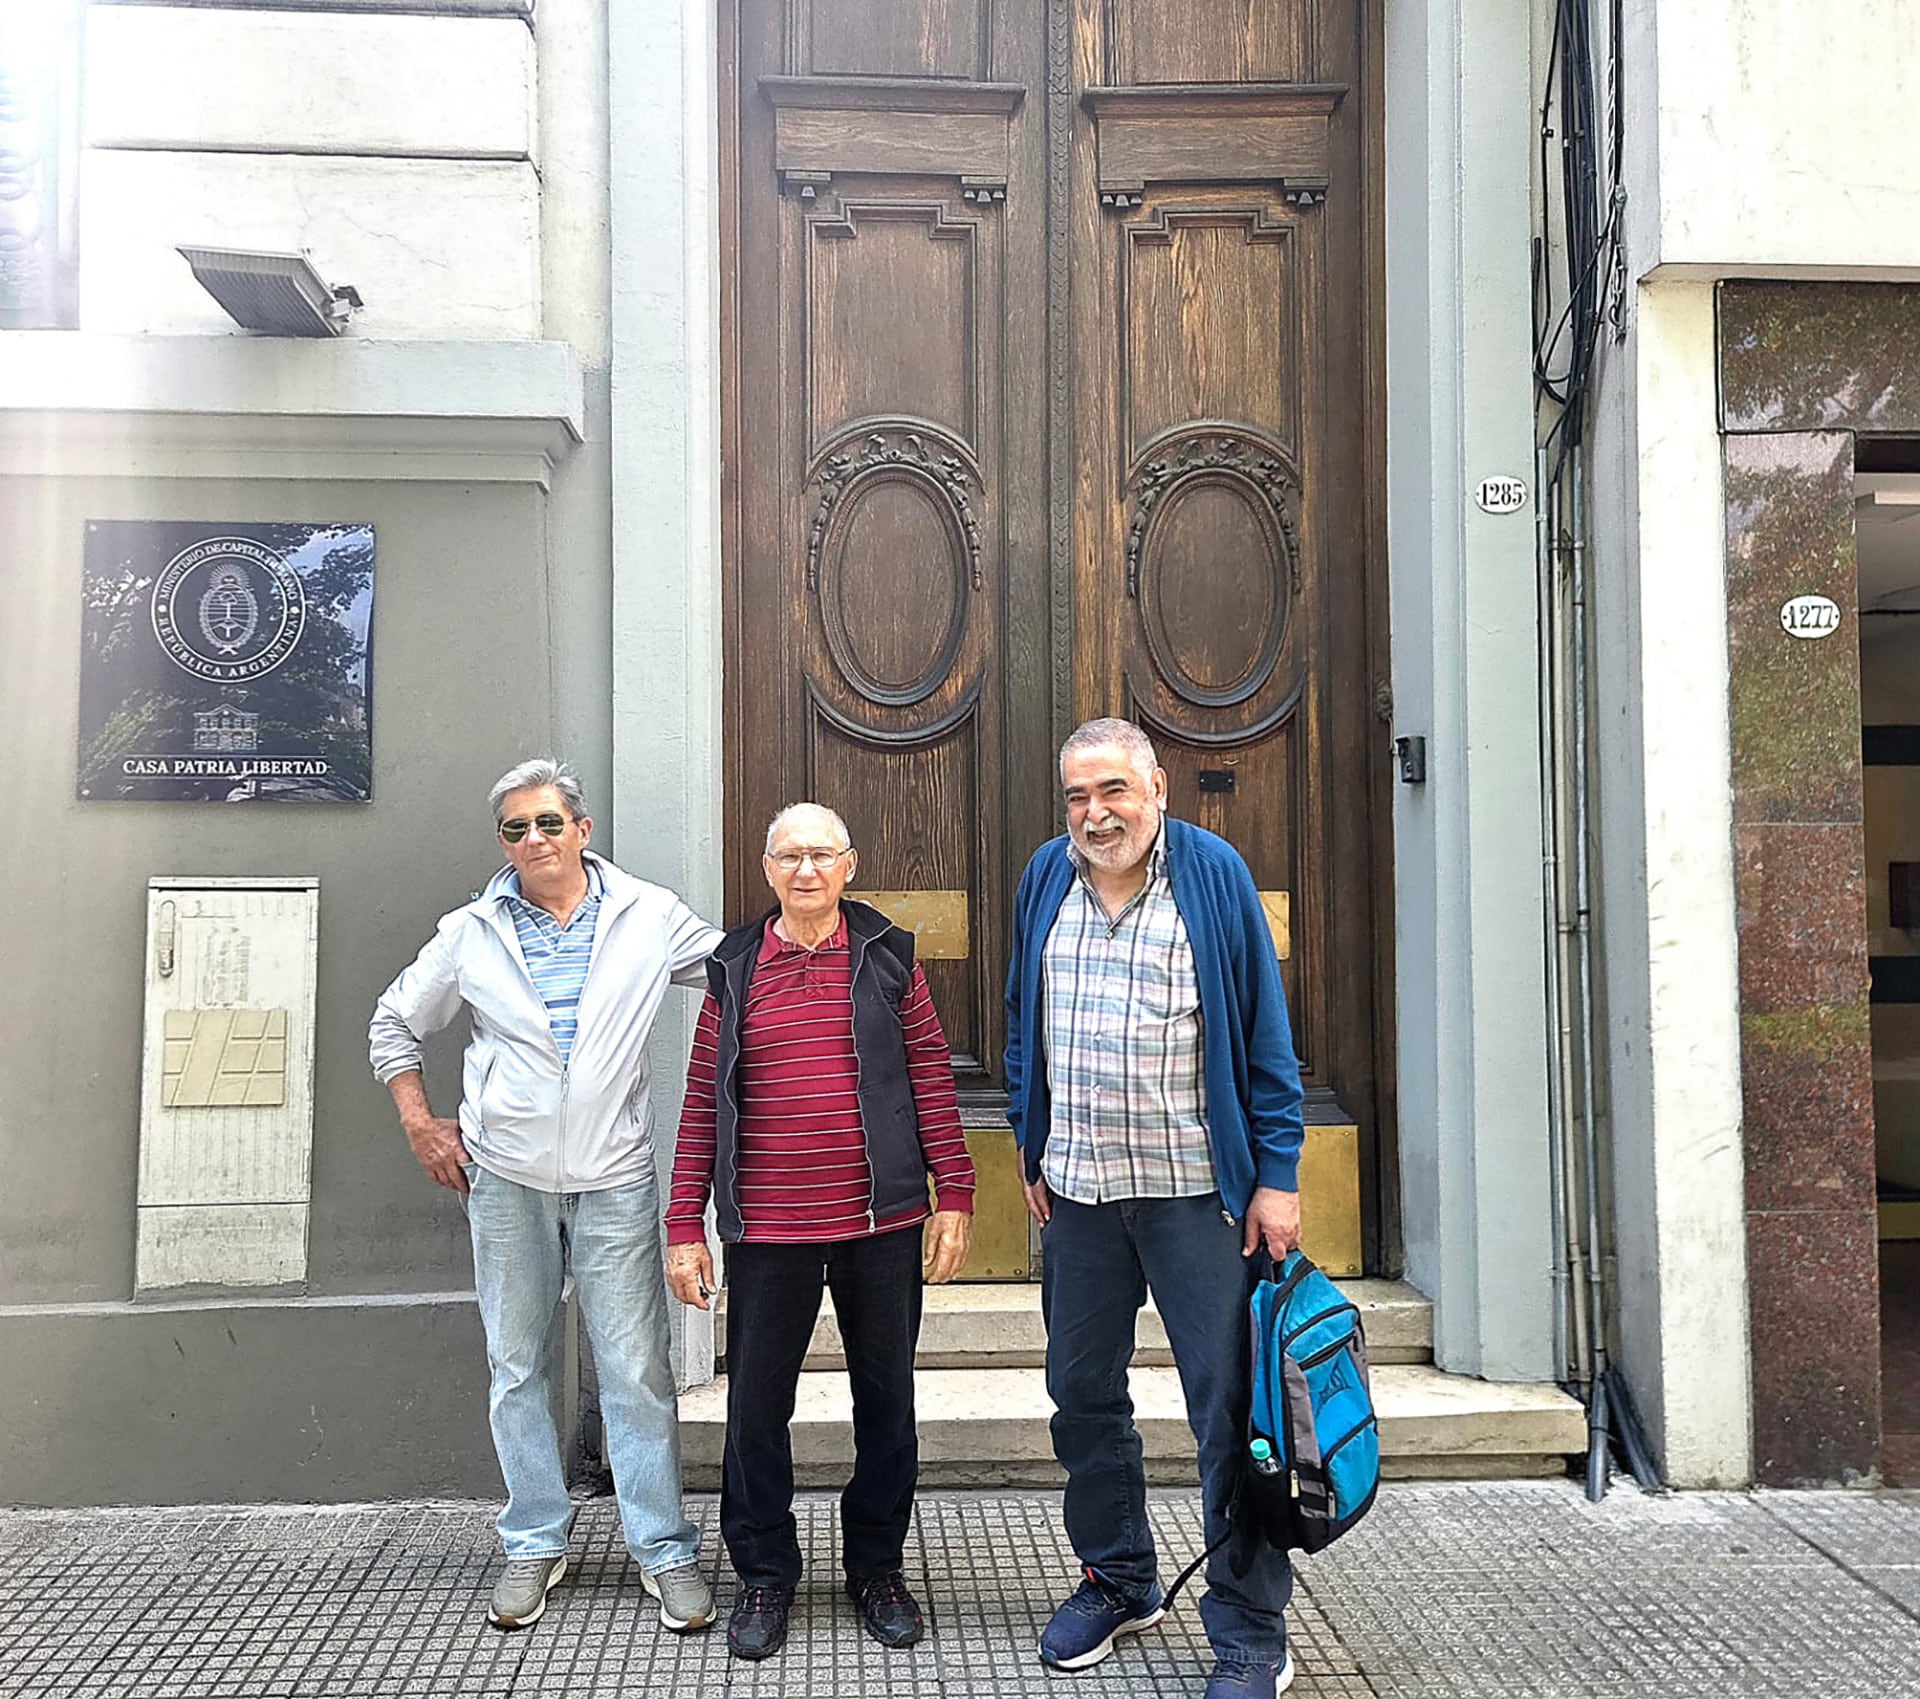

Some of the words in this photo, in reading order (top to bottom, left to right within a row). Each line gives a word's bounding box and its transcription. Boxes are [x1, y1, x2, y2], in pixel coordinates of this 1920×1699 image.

[1480, 482, 1524, 507] 1285
[158, 549, 205, 601] MINISTERIO
[205, 543, 222, 556] DE
[222, 542, 266, 561] CAPITAL
[1787, 604, 1834, 629] 1277
[158, 618, 222, 677] REPÚBLICA
[228, 619, 299, 677] ARGENTINA
[123, 760, 169, 775] CASA
[174, 760, 237, 775] PATRIA
[241, 760, 328, 775] LIBERTAD
